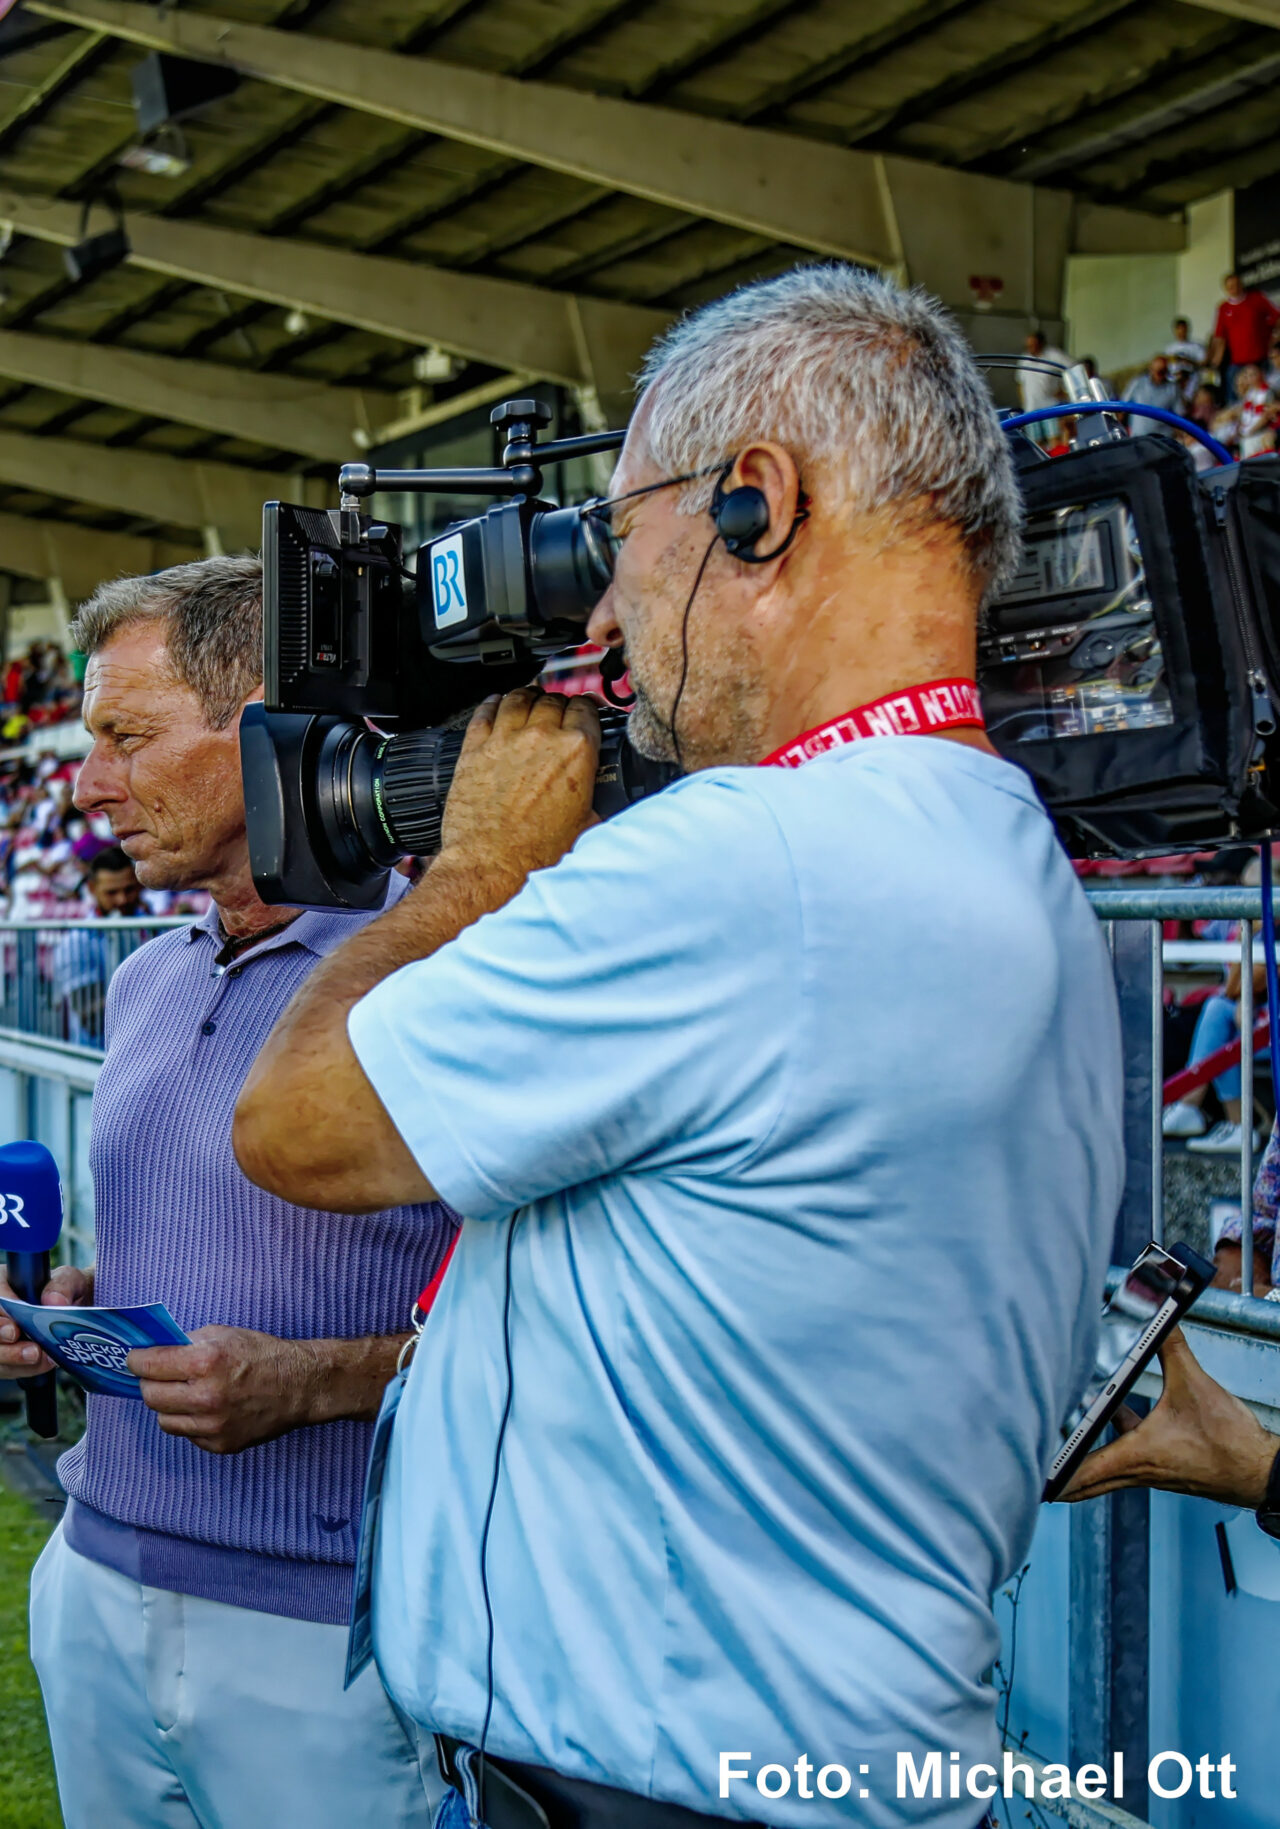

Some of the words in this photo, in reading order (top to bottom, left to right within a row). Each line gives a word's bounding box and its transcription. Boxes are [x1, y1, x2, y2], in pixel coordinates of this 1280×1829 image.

[433, 550, 465, 616] BR
[862, 696, 922, 736] EIN
[374, 778, 386, 822] CORPORATION
